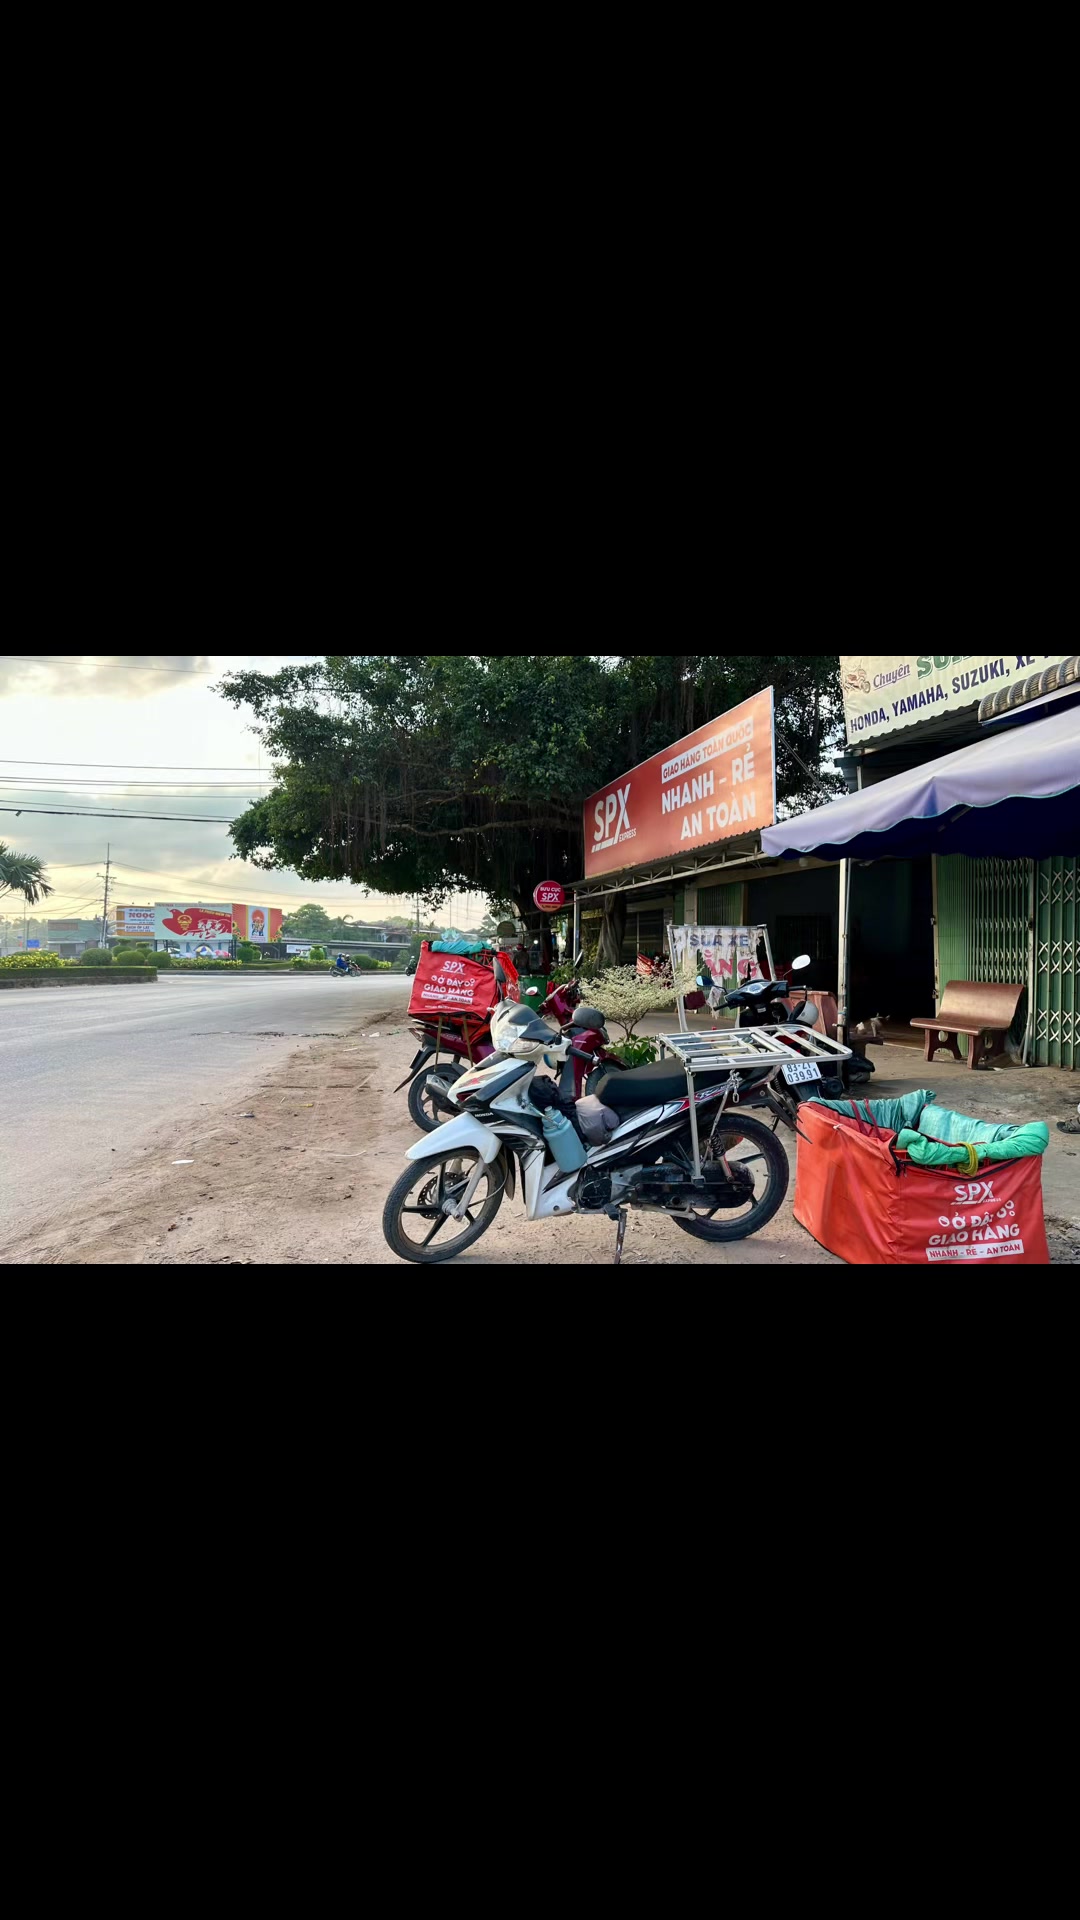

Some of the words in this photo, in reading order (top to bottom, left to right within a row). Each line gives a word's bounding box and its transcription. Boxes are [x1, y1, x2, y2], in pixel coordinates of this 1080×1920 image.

[873, 664, 911, 688] Chuyên
[850, 708, 890, 733] HONDA,
[892, 684, 949, 717] YAMAHA,
[951, 658, 1010, 694] SUZUKI,
[662, 762, 680, 779] GIAO
[680, 750, 701, 771] HÀNG
[702, 737, 725, 759] TOÀN
[725, 722, 752, 746] QUỐC
[661, 769, 715, 815] NHANH
[731, 743, 755, 786] RẺ
[592, 783, 632, 845] SPX
[680, 810, 703, 841] AN
[706, 791, 756, 832] TOÀN
[618, 827, 637, 843] EXPRESS
[541, 892, 560, 902] SPX
[728, 934, 749, 947] XE
[441, 961, 466, 974] SPX
[423, 983, 446, 993] GIAO
[447, 986, 474, 997] HÀNG
[787, 1067, 819, 1083] 039.91
[953, 1180, 994, 1204] SPX
[951, 1211, 966, 1230] Ở
[928, 1231, 968, 1246] GIAO
[972, 1223, 1020, 1242] HÀNG
[929, 1249, 958, 1259] NHANH
[986, 1246, 999, 1255] AN
[999, 1243, 1021, 1254] TOÀN
